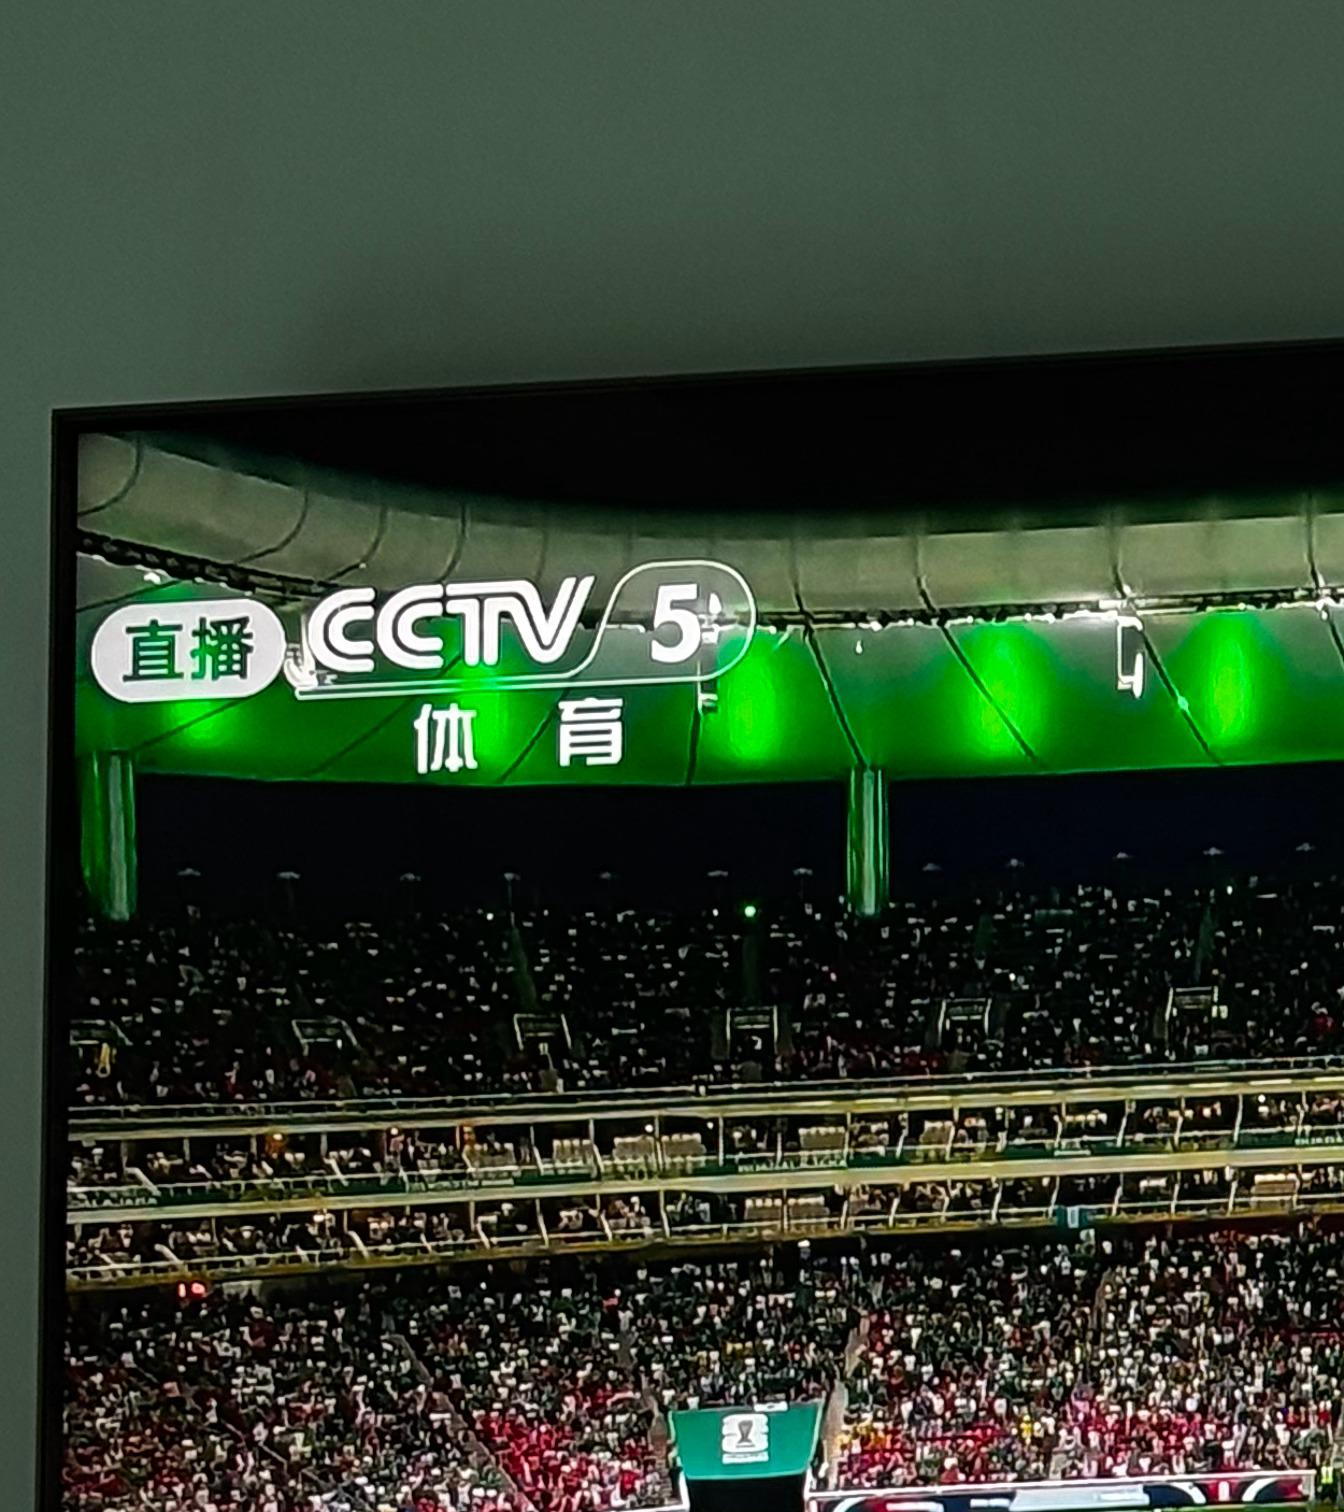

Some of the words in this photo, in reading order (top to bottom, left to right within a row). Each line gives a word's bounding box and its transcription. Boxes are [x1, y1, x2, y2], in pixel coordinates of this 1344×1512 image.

[122, 616, 254, 683] 直播
[307, 575, 596, 673] CCTV
[650, 583, 700, 664] 5
[413, 698, 624, 774] 体育
